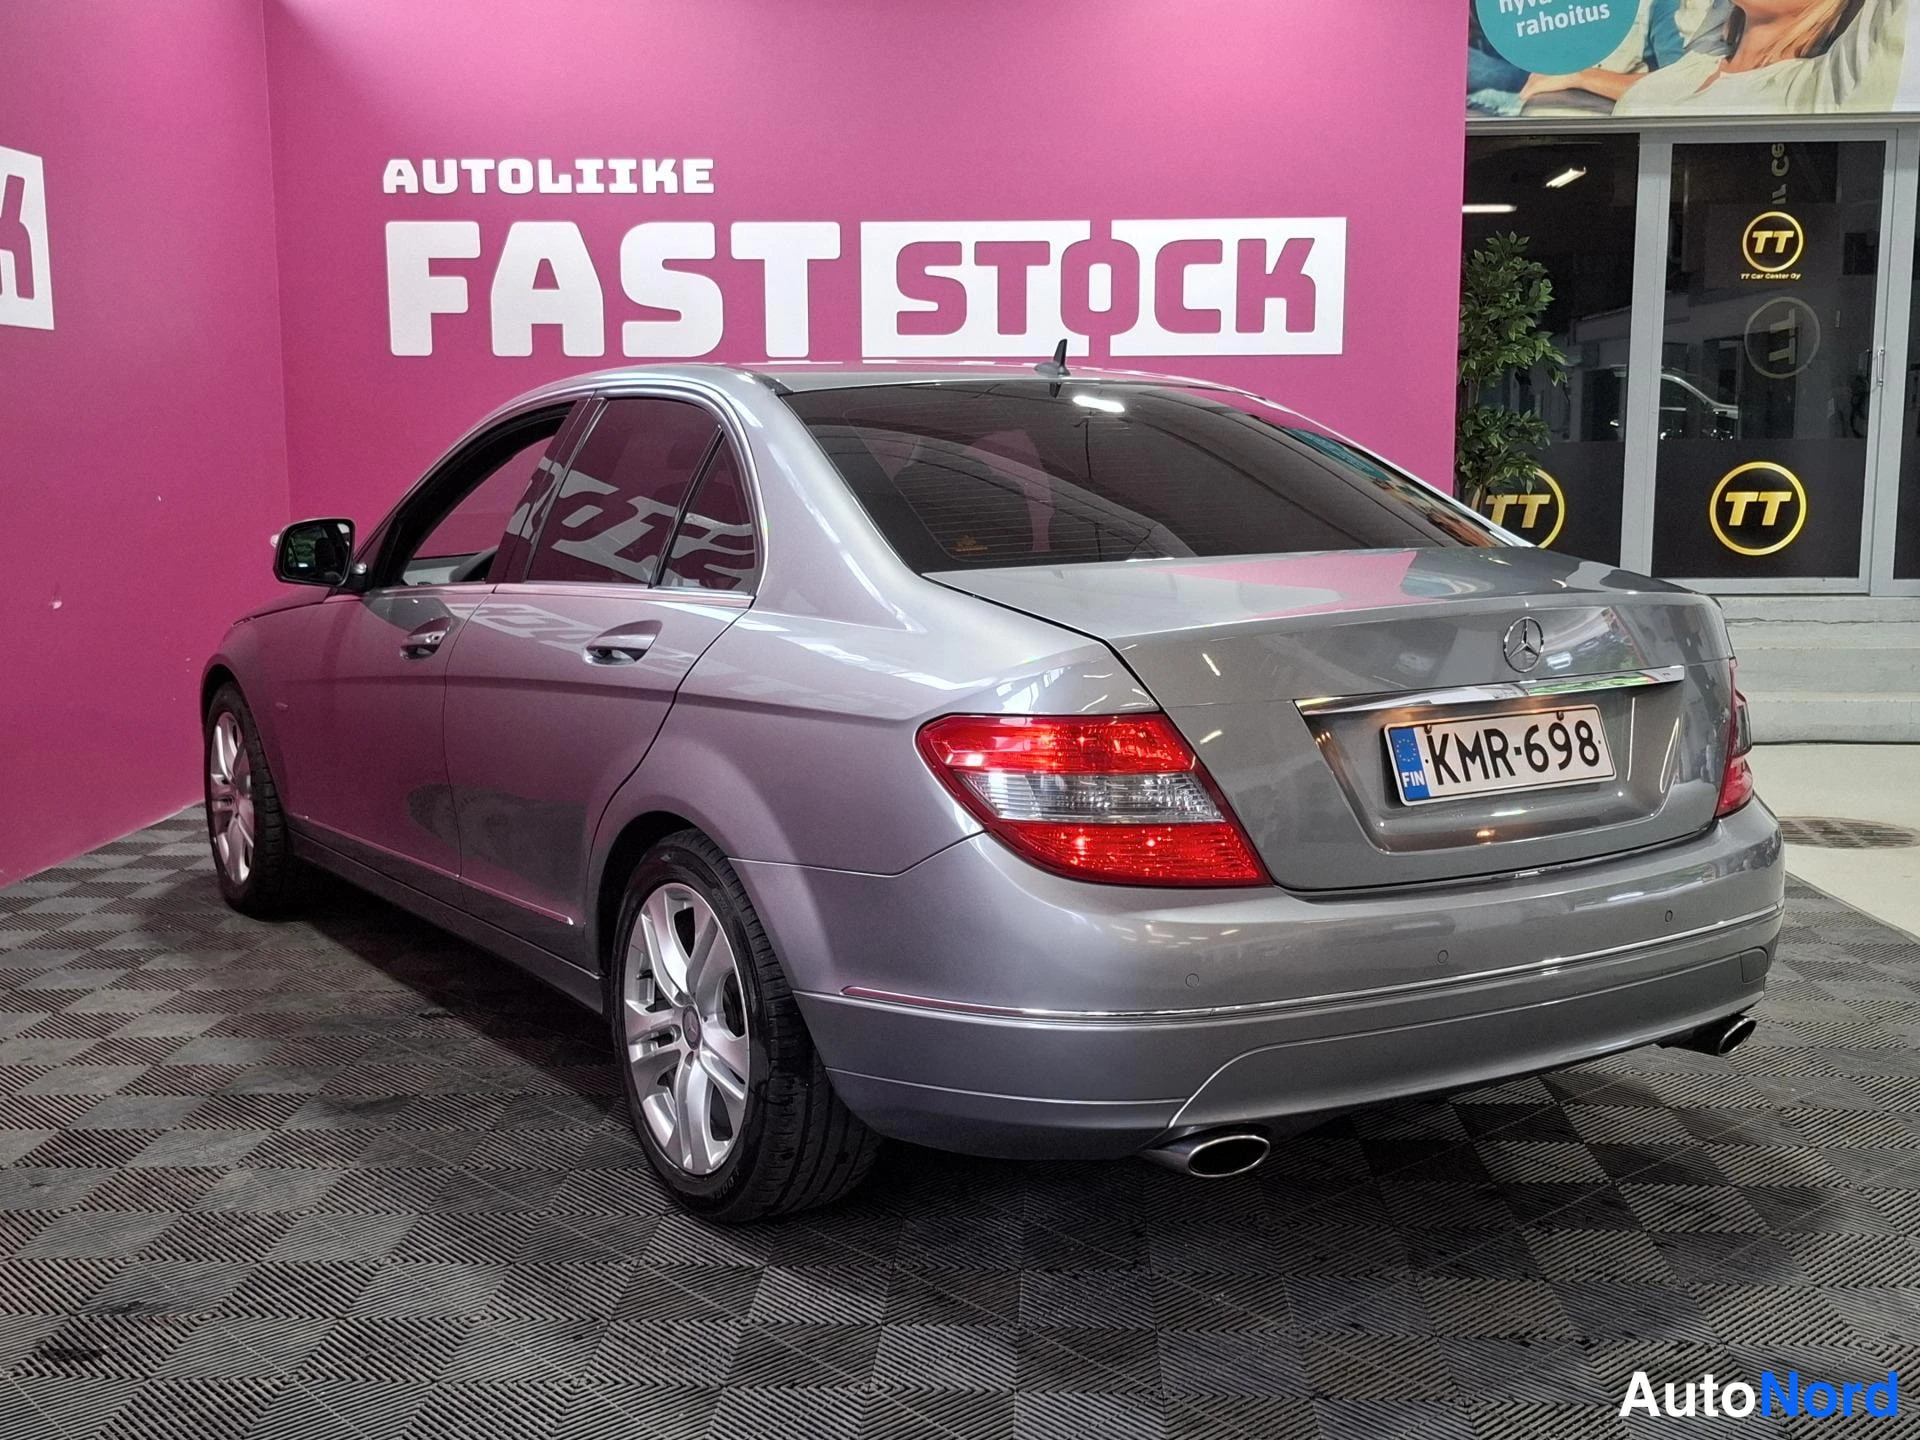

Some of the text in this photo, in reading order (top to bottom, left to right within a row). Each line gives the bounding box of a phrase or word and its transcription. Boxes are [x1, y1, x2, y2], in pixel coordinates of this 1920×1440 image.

[1516, 4, 1610, 37] rahoitus
[383, 158, 714, 194] AUTOLIIKE
[1752, 230, 1795, 253] TT
[385, 221, 1316, 357] FAST STOCK
[1485, 494, 1551, 529] TT
[1725, 491, 1793, 526] TT
[1401, 720, 1600, 788] FIN KMR-698
